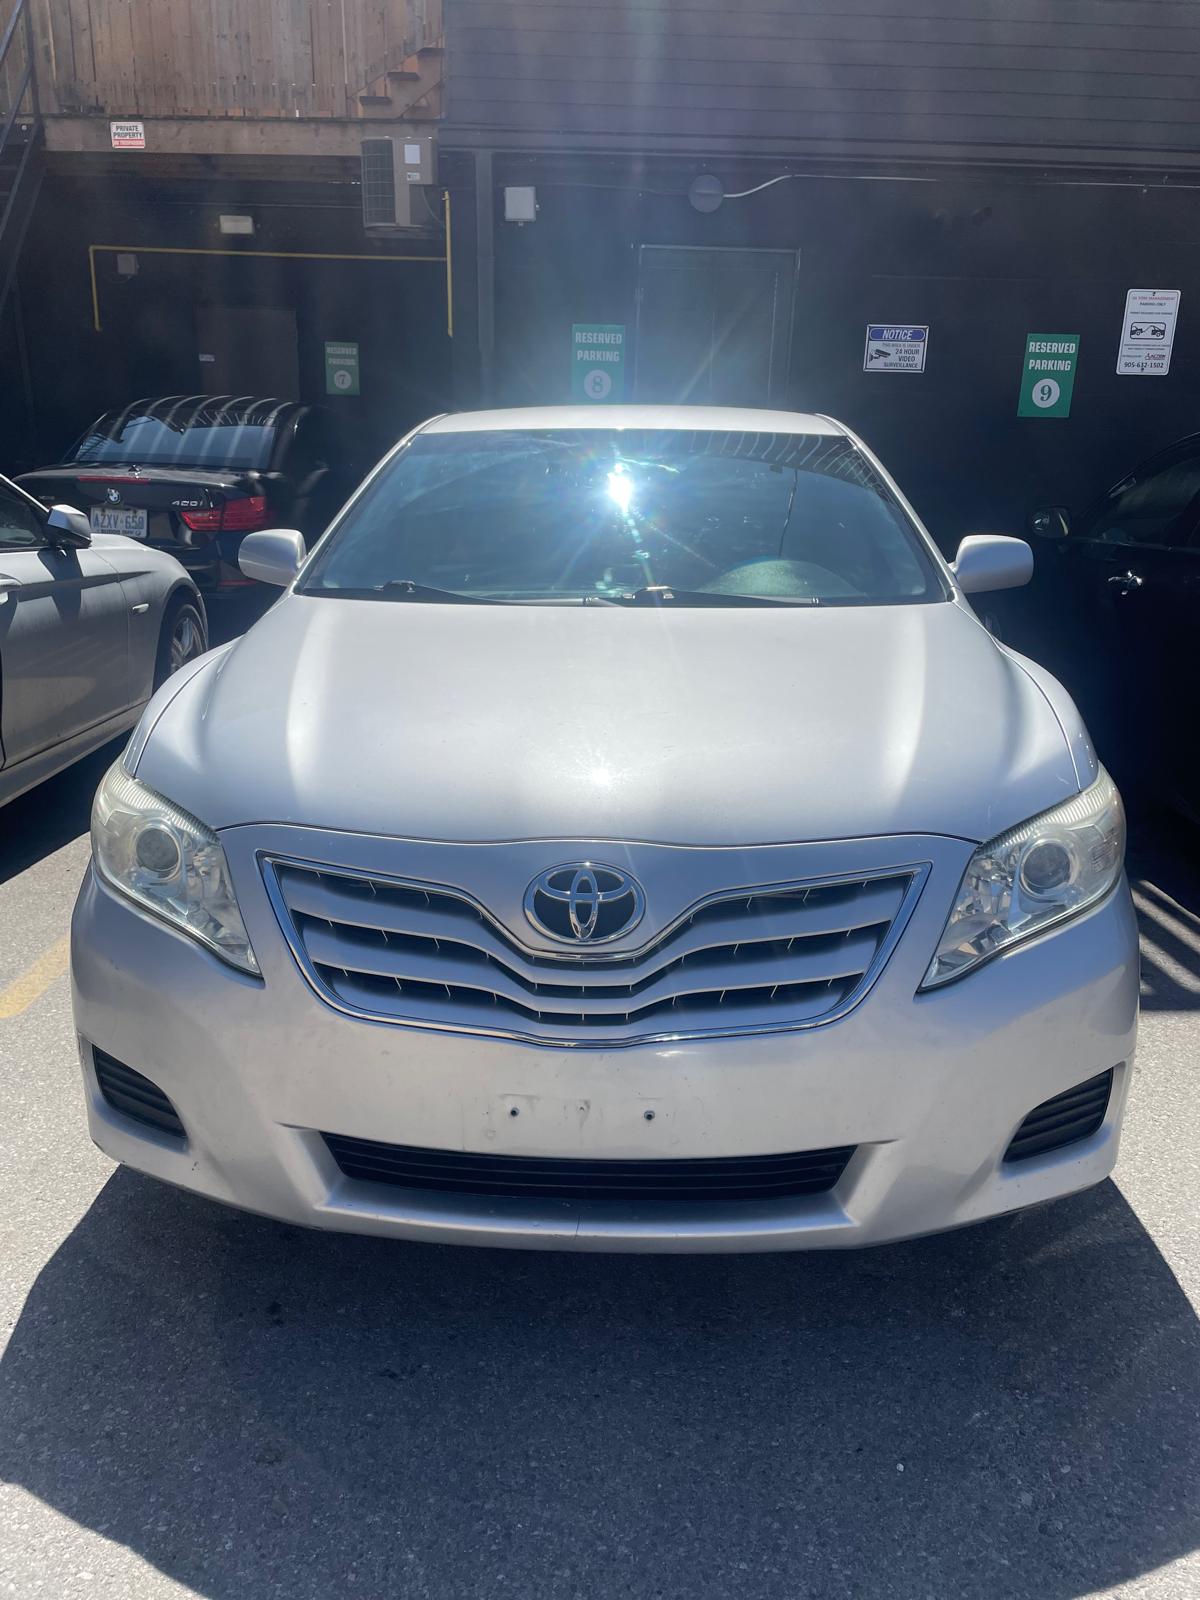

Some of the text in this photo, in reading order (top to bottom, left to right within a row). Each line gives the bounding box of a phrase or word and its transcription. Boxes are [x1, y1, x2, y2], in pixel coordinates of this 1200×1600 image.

[575, 332, 623, 345] RESERVED
[882, 329, 914, 340] NOTICE
[903, 348, 920, 356] HOUR
[1028, 342, 1076, 354] RESERVED
[576, 350, 621, 362] PARKING
[1028, 359, 1072, 371] PARKING
[339, 374, 347, 385] 7
[592, 375, 604, 393] 8
[1040, 384, 1053, 402] 9
